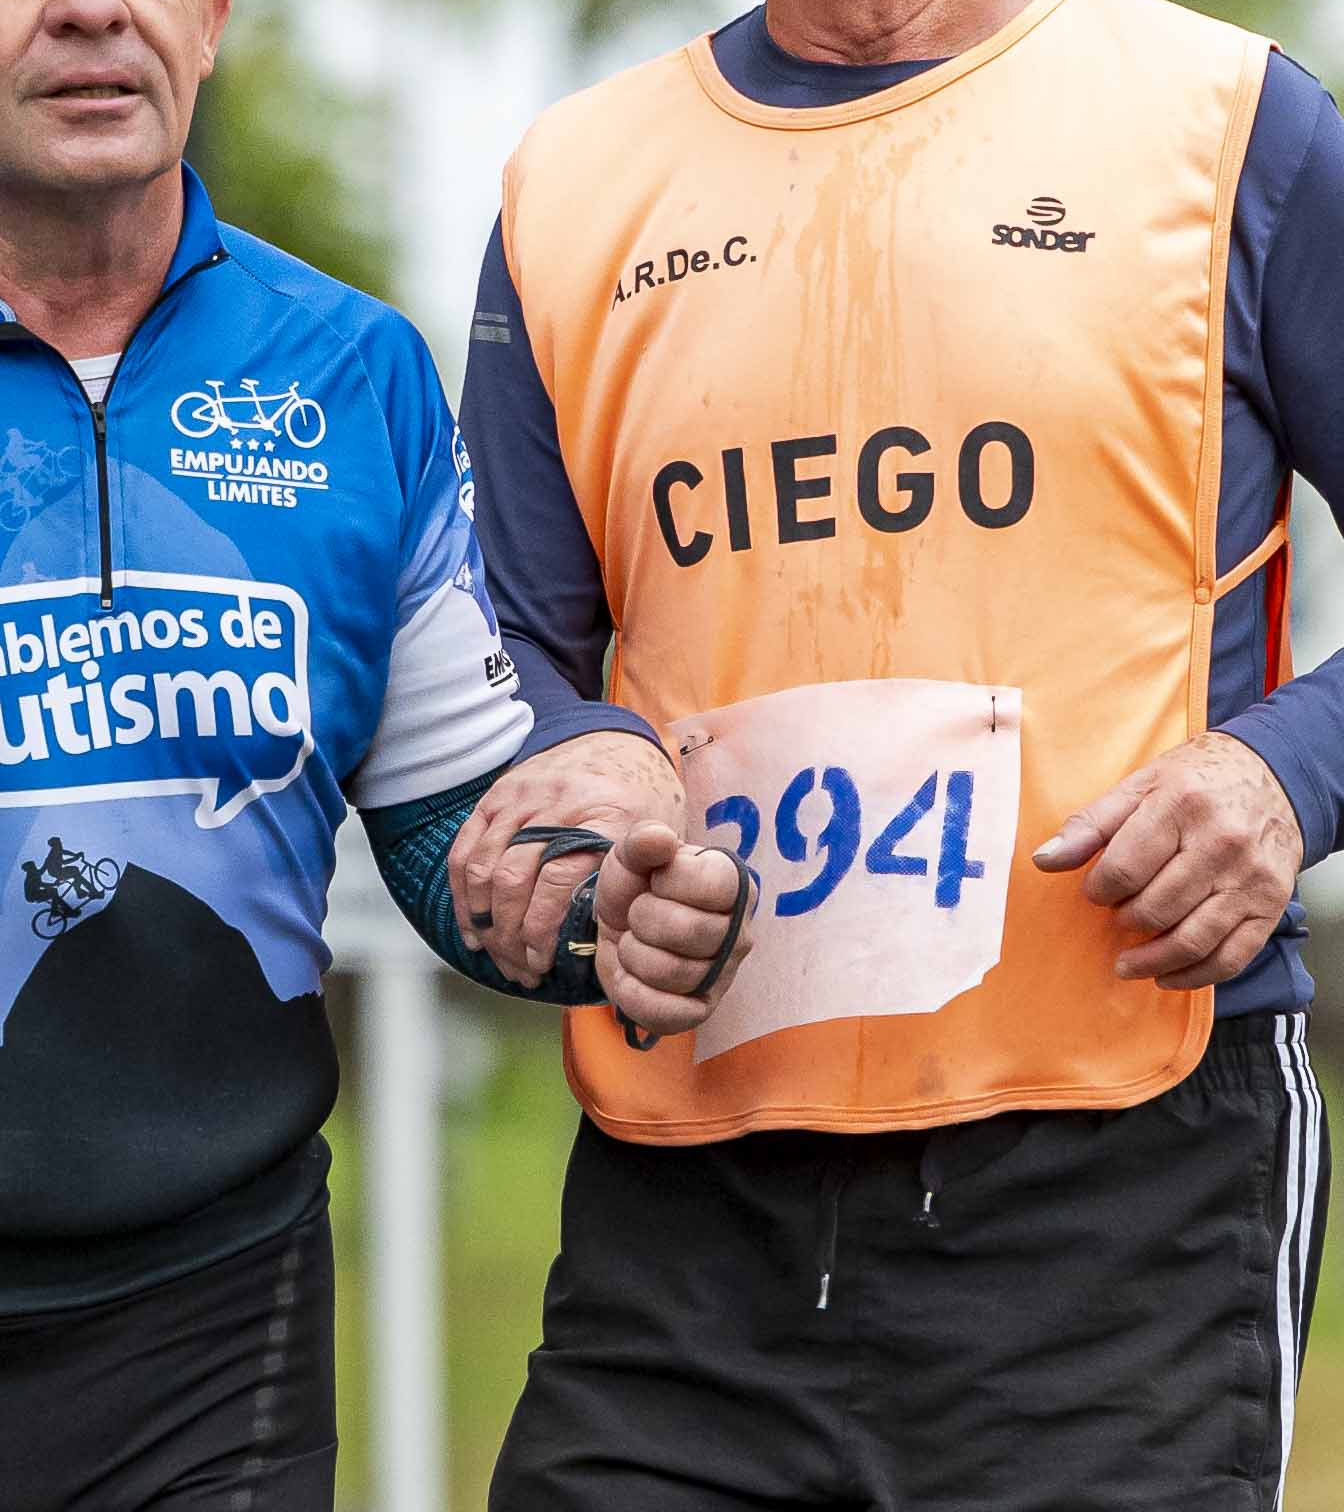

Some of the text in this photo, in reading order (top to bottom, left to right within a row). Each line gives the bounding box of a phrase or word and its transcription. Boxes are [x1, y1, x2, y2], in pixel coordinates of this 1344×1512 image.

[170, 447, 329, 483] EMPUJANDO
[207, 480, 298, 508] LIMITES
[652, 420, 1036, 568] CIEGO
[220, 594, 283, 650] de
